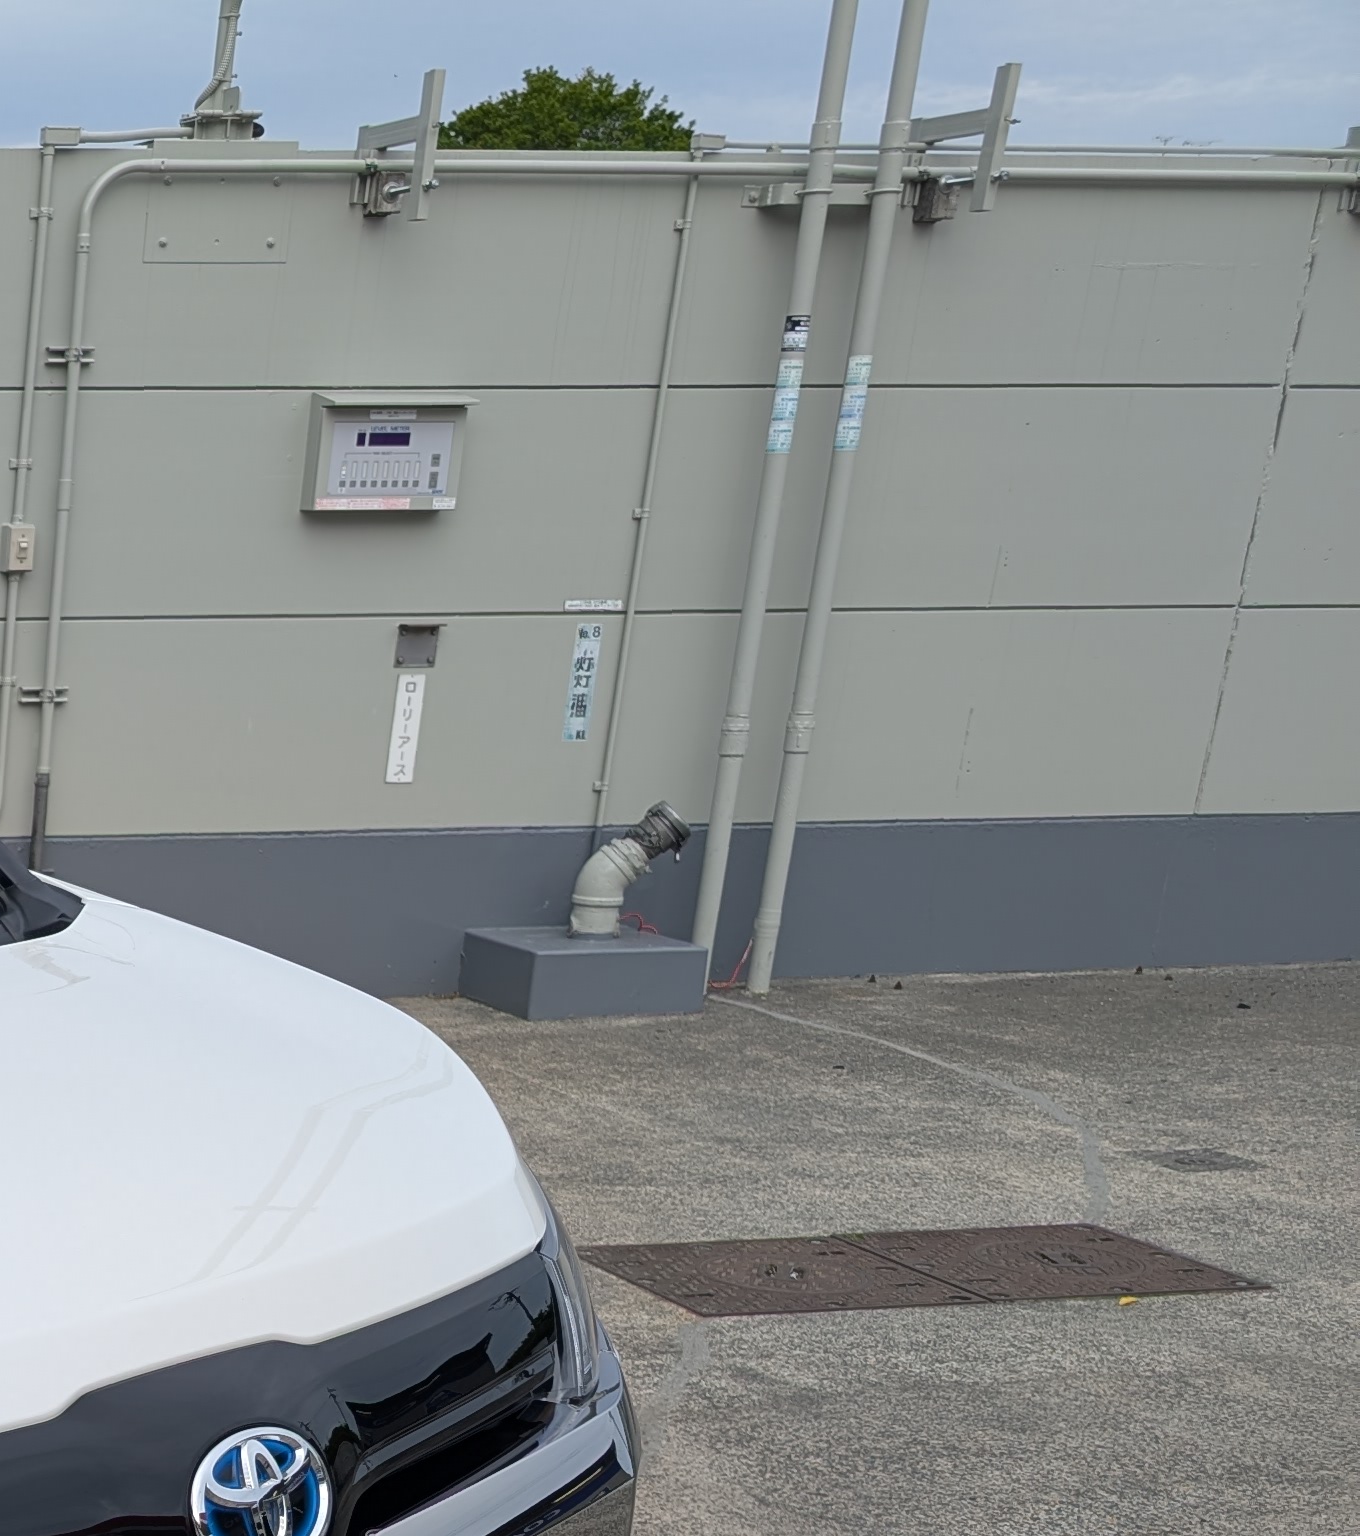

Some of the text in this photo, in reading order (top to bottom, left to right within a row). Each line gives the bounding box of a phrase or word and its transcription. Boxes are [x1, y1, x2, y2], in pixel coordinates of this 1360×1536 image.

[591, 625, 602, 639] 8
[393, 681, 417, 777] ローリーアース
